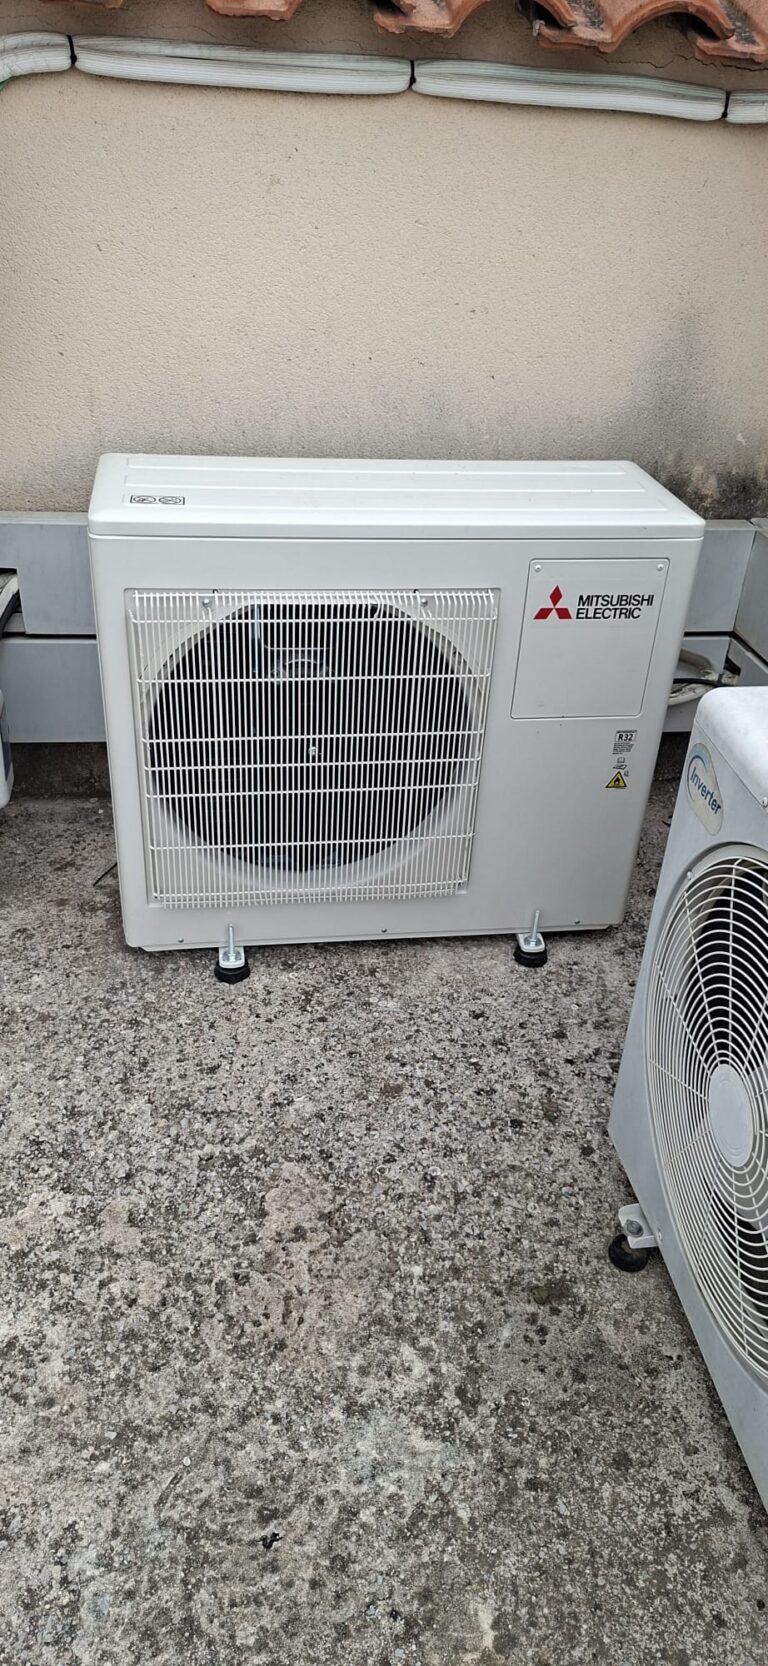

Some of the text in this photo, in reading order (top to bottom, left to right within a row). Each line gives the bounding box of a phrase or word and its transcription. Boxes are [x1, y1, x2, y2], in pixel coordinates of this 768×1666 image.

[577, 594, 655, 607] MITSUBISHI
[575, 607, 642, 620] ELECTRIC
[617, 733, 634, 742] R32
[690, 767, 722, 815] Inverter
